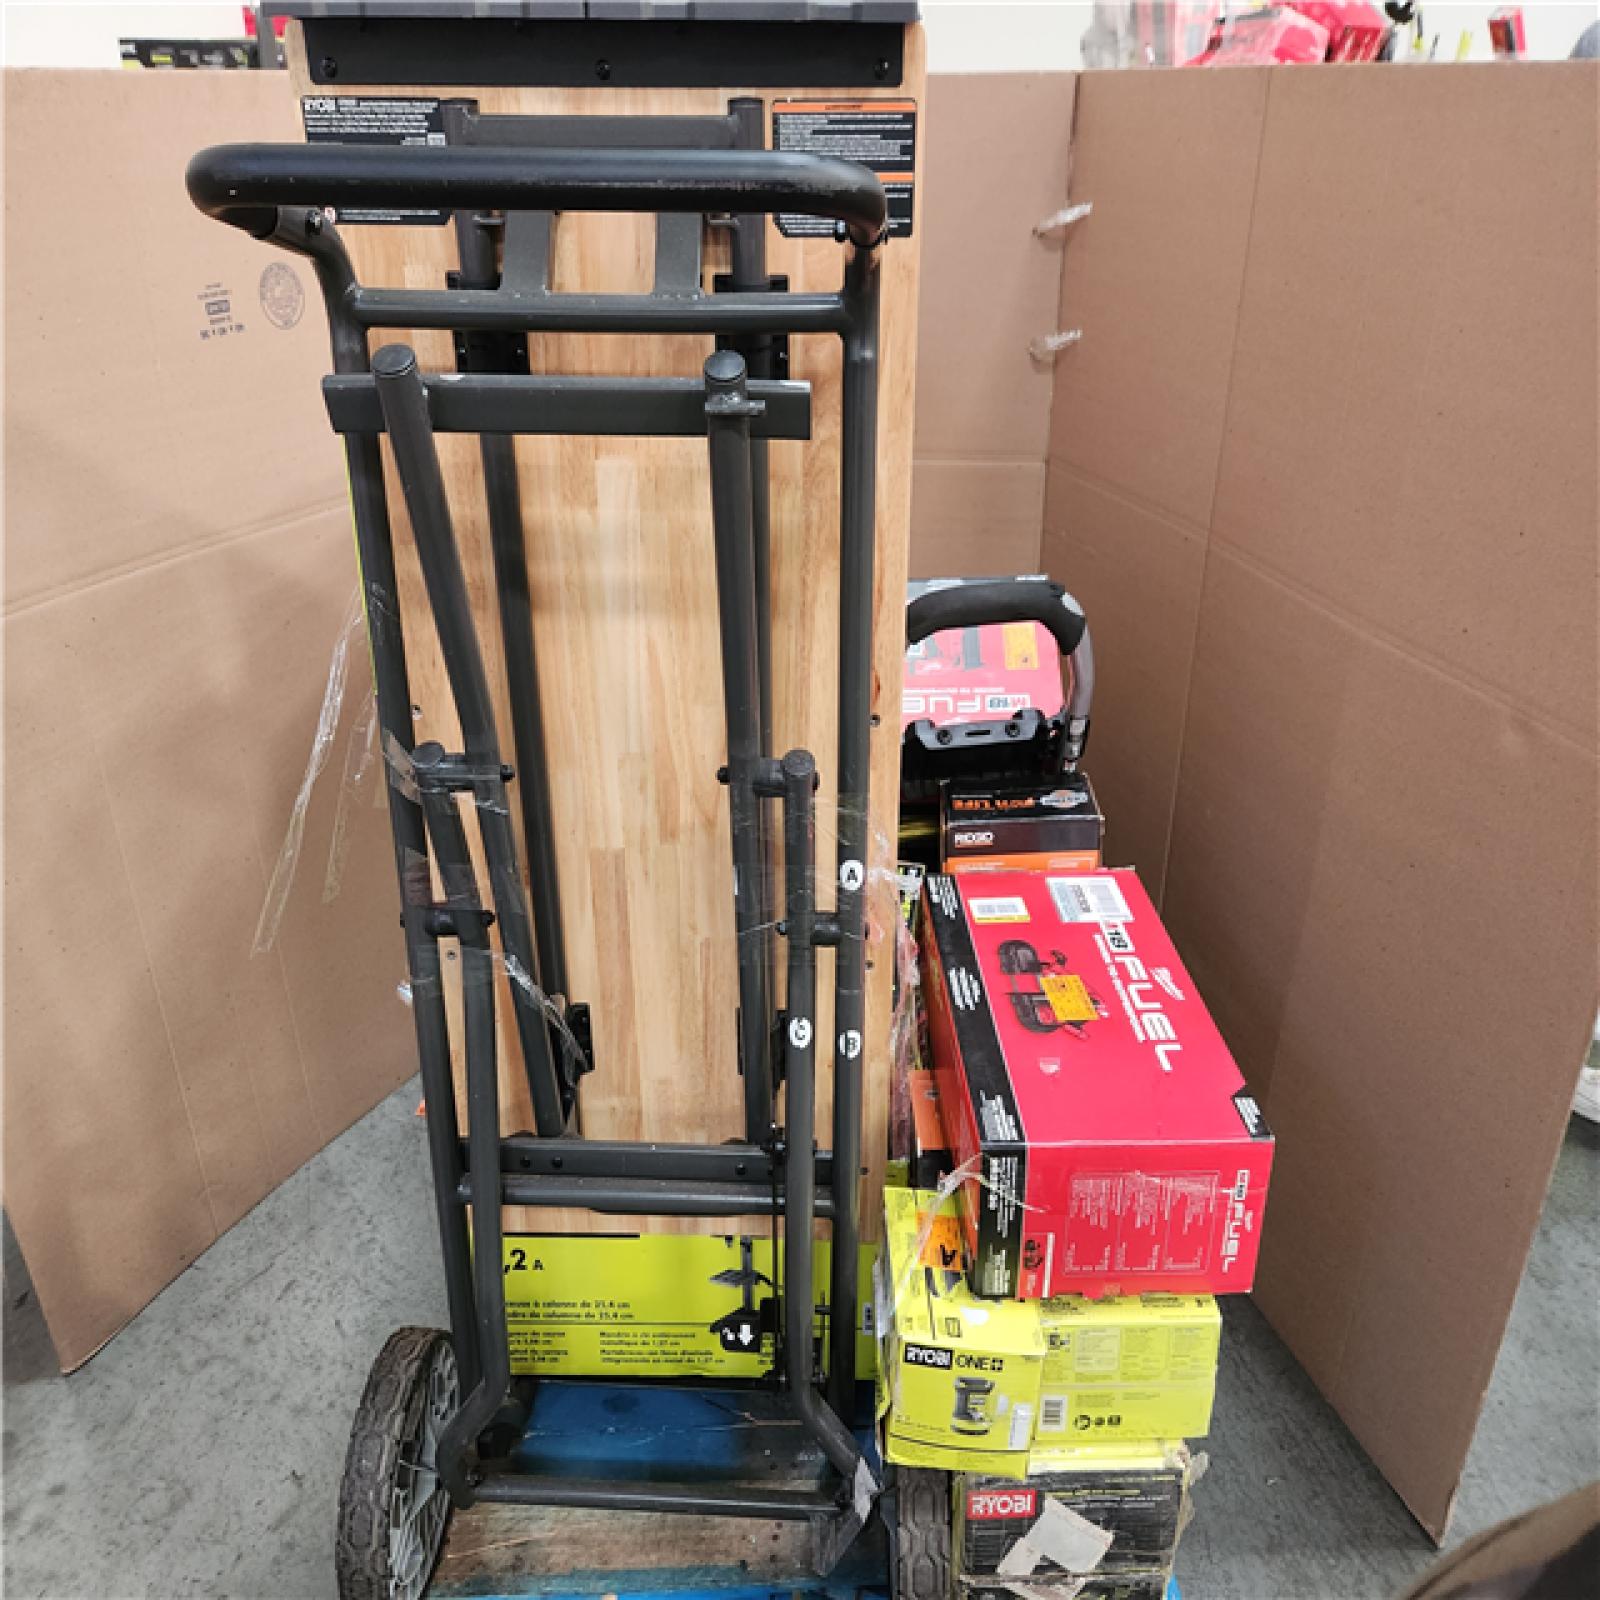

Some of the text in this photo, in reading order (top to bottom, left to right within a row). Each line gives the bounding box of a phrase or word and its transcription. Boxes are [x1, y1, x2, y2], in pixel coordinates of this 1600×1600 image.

[1113, 954, 1184, 1072] FUEL
[1222, 1202, 1244, 1273] FUEL
[906, 1346, 951, 1366] RYOBI
[971, 1494, 1032, 1515] RYOBI
